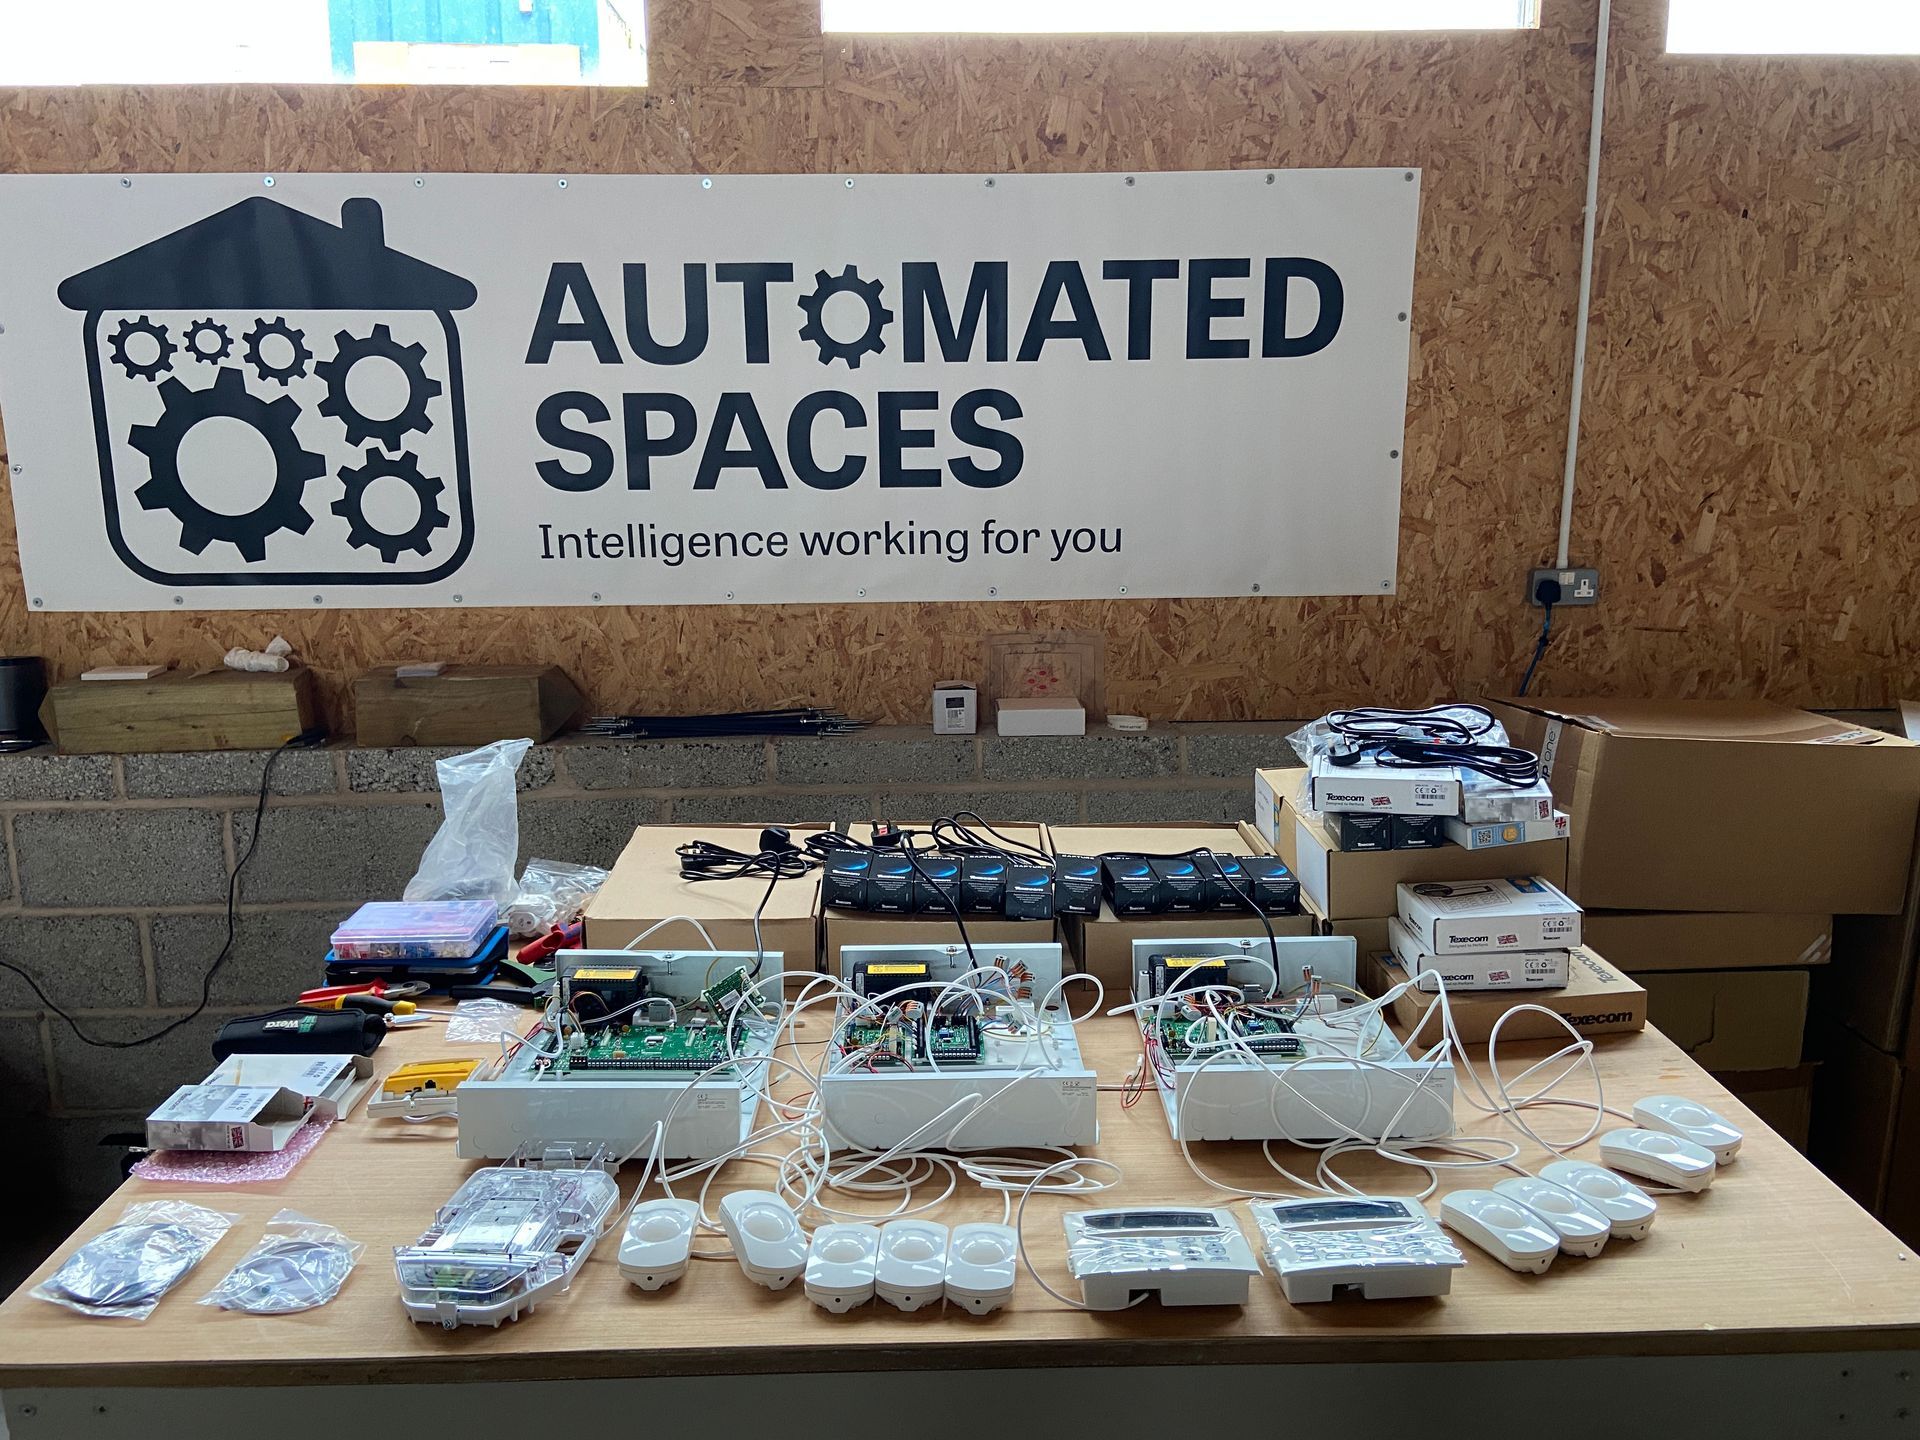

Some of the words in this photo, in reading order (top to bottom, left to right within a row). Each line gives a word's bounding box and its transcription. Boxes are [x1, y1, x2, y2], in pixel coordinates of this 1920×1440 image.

[535, 389, 1024, 492] SPACES
[539, 524, 788, 566] Intelligence
[800, 520, 969, 564] working
[980, 519, 1041, 555] for
[1051, 527, 1122, 562] you
[1545, 731, 1556, 761] one
[1326, 792, 1365, 802] Texecom
[1449, 935, 1489, 944] Texecom
[265, 1020, 299, 1029] Wera
